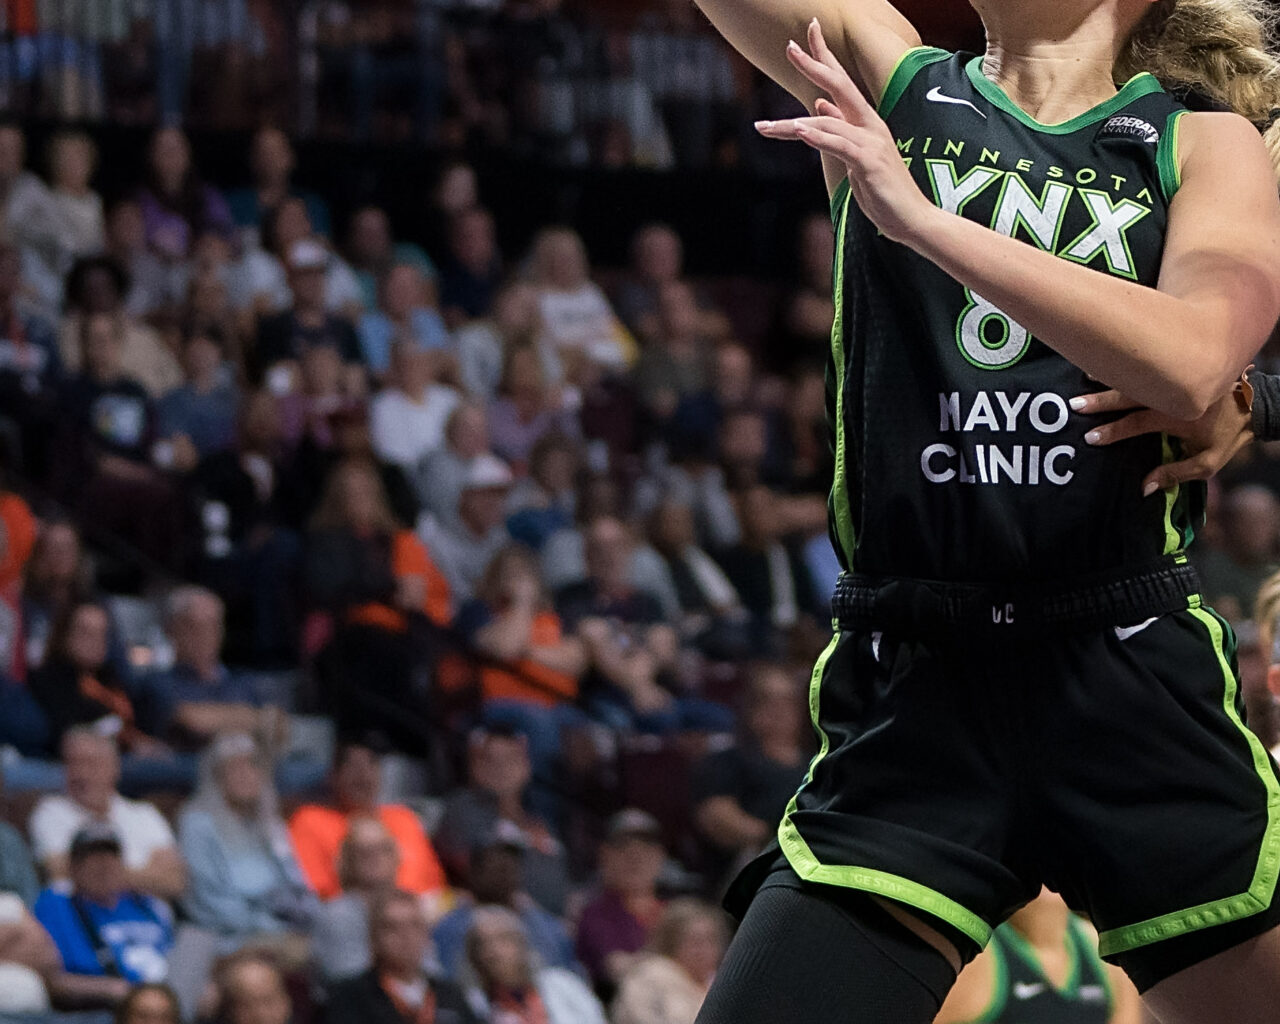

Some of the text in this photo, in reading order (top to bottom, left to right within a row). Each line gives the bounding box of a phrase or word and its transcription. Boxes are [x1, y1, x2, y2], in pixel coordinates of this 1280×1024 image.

[900, 157, 1152, 280] YNX
[956, 286, 1032, 370] 8
[938, 391, 1069, 434] MAYO
[920, 443, 1076, 486] CLINIC
